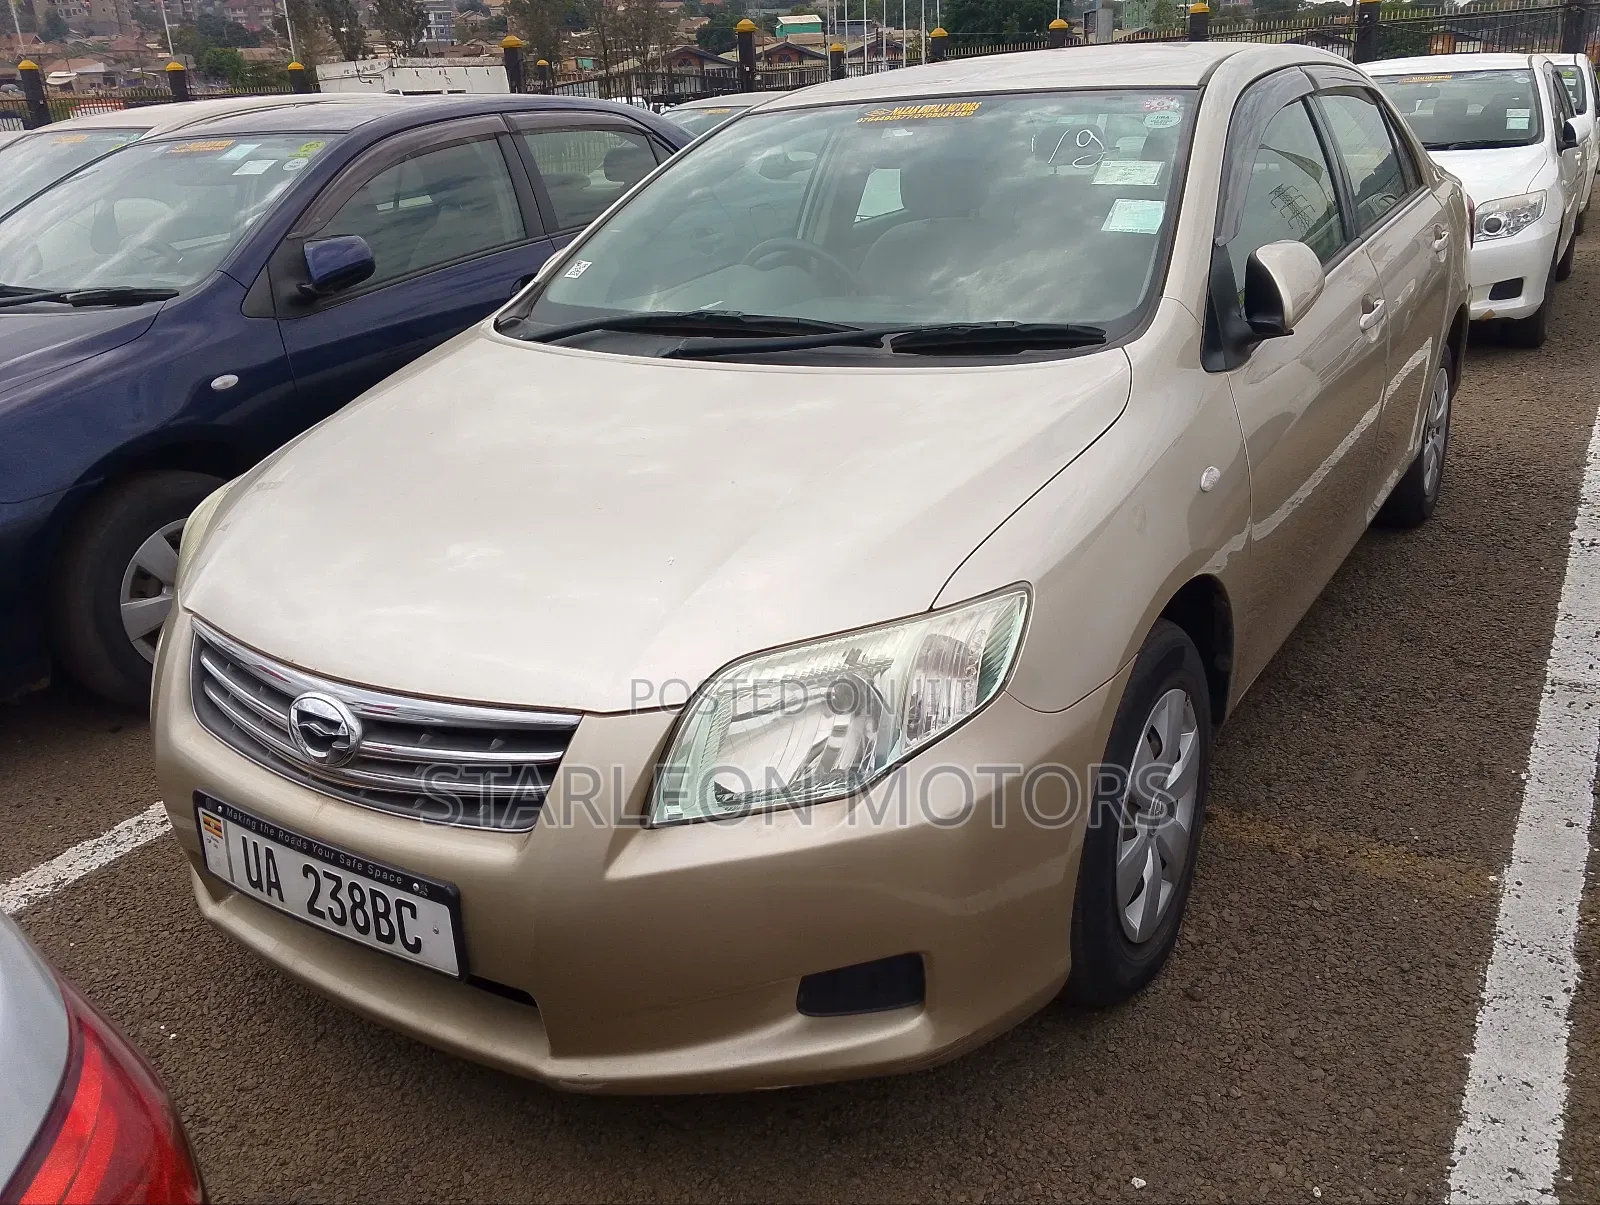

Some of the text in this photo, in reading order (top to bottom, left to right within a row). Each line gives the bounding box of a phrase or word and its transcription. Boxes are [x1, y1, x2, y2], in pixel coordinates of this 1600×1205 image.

[944, 101, 982, 113] MOTORS
[226, 807, 403, 886] Making the Roads Your Safe Space
[240, 835, 423, 955] UA 238BC
